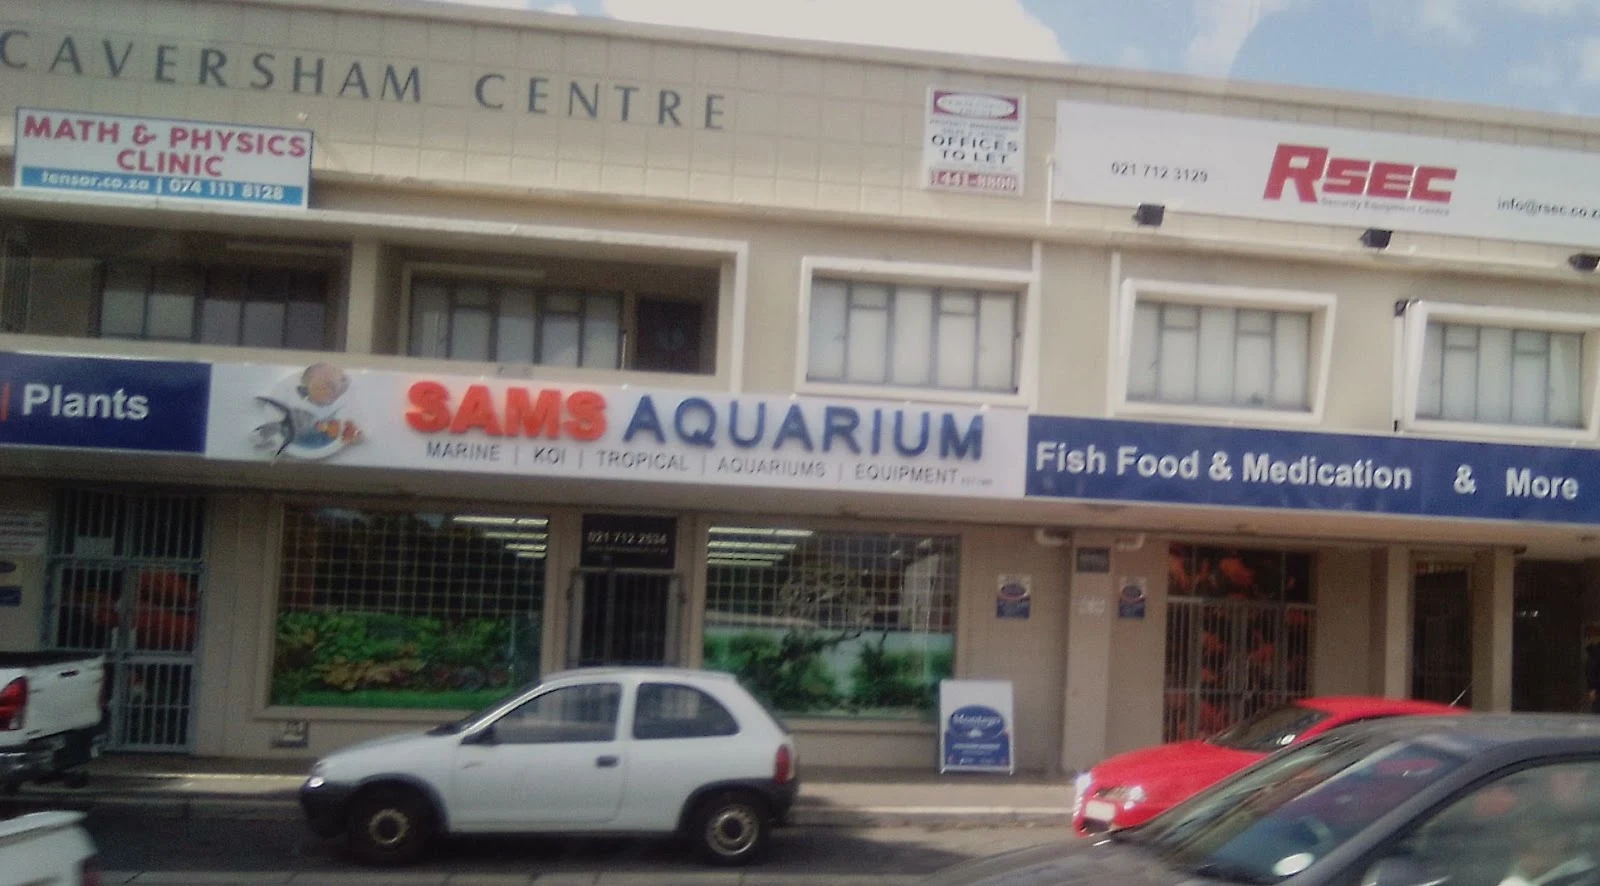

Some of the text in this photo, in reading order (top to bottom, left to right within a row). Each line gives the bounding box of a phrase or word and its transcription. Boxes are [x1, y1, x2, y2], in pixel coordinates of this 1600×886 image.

[0, 29, 725, 130] CAVERSHAM CENTRE
[24, 115, 306, 158] MATH & PHYSICS
[932, 135, 1018, 152] OFFICES
[117, 149, 224, 177] CLINIC
[942, 149, 1008, 165] TO LET
[1111, 161, 1208, 183] 021 712 3129
[41, 171, 284, 201] tensor.co.za 074 111 8128
[23, 383, 149, 420] Plants
[405, 380, 984, 461] SAMS AQUARIUM
[426, 441, 502, 461] MARINE
[533, 446, 566, 464] KOI
[597, 449, 689, 471] TROPICAL
[717, 456, 826, 478] AQUARIUMS
[855, 463, 958, 485] EQUIPMENT
[1035, 441, 1580, 501] Fish Food & Medication & More
